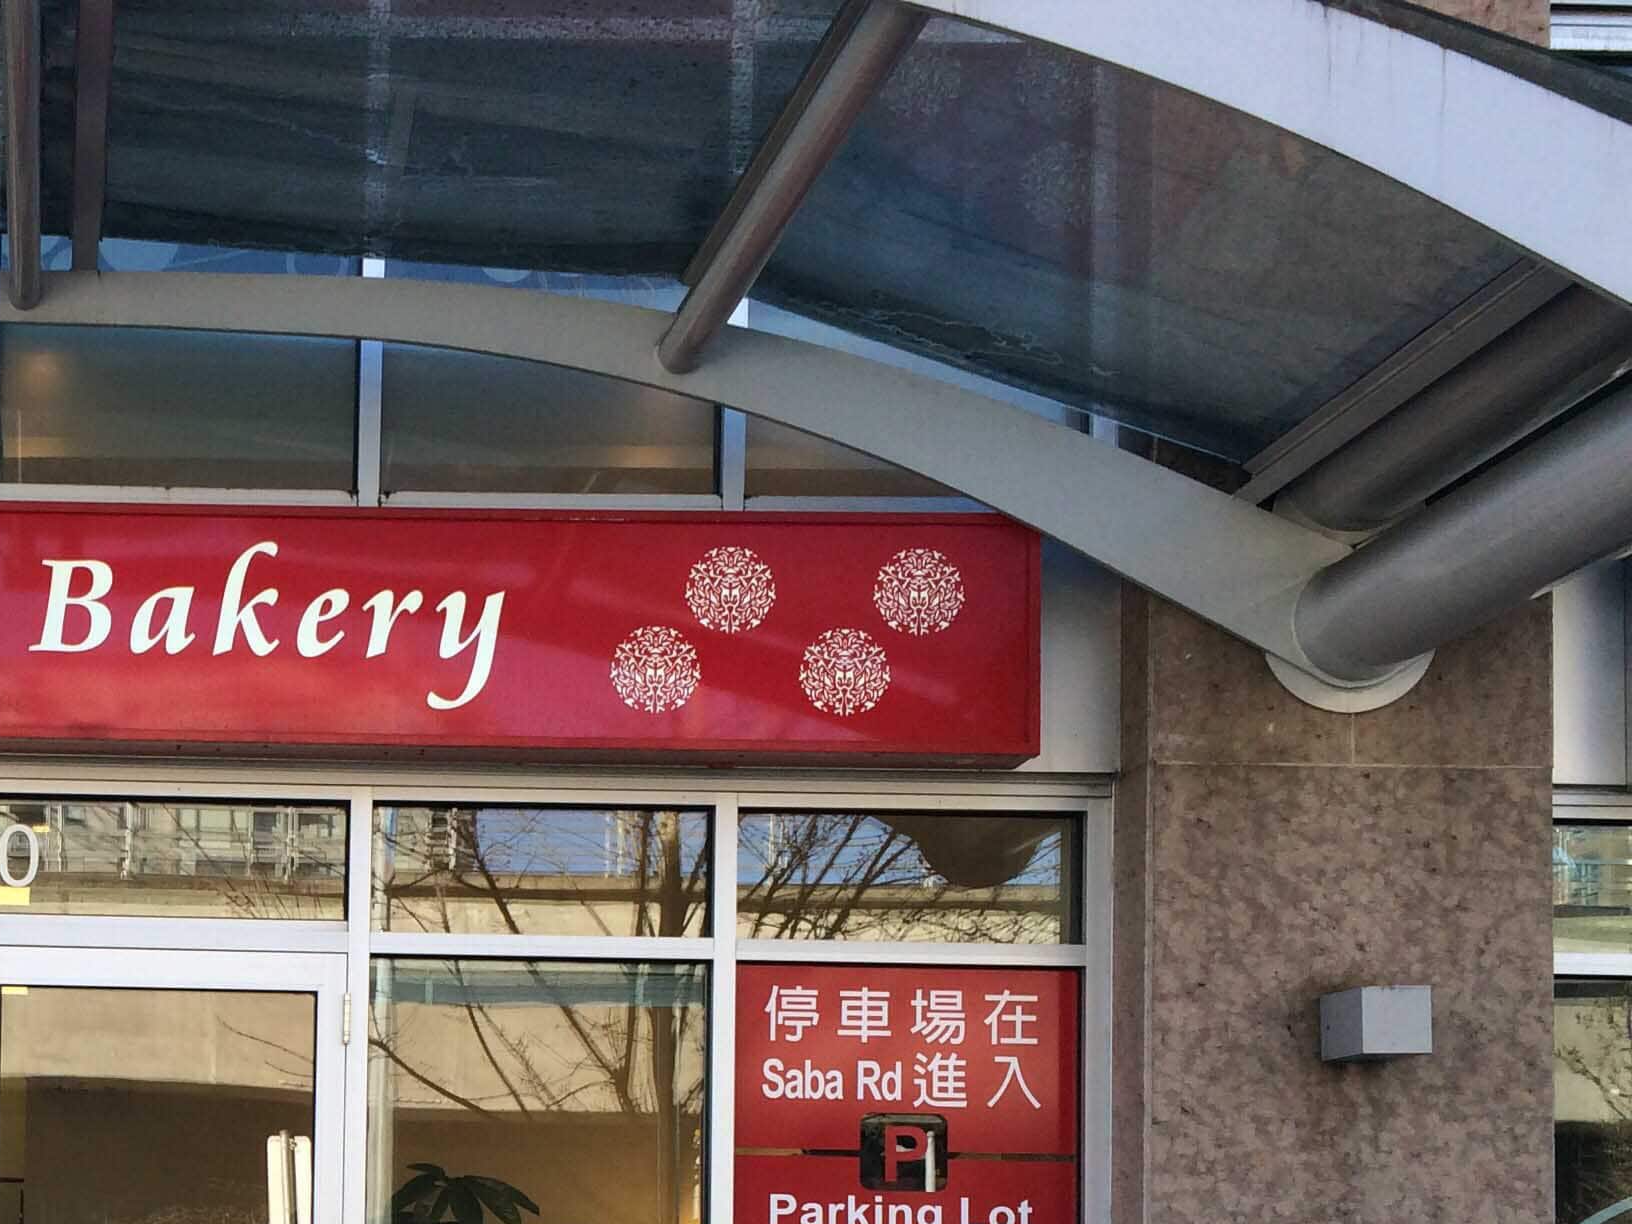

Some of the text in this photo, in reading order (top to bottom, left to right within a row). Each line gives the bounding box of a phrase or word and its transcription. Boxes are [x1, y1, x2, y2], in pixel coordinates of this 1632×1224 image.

[28, 541, 505, 710] Bakery
[764, 985, 1039, 1045] 停車場在
[761, 1052, 1041, 1109] Saba Rd 進入
